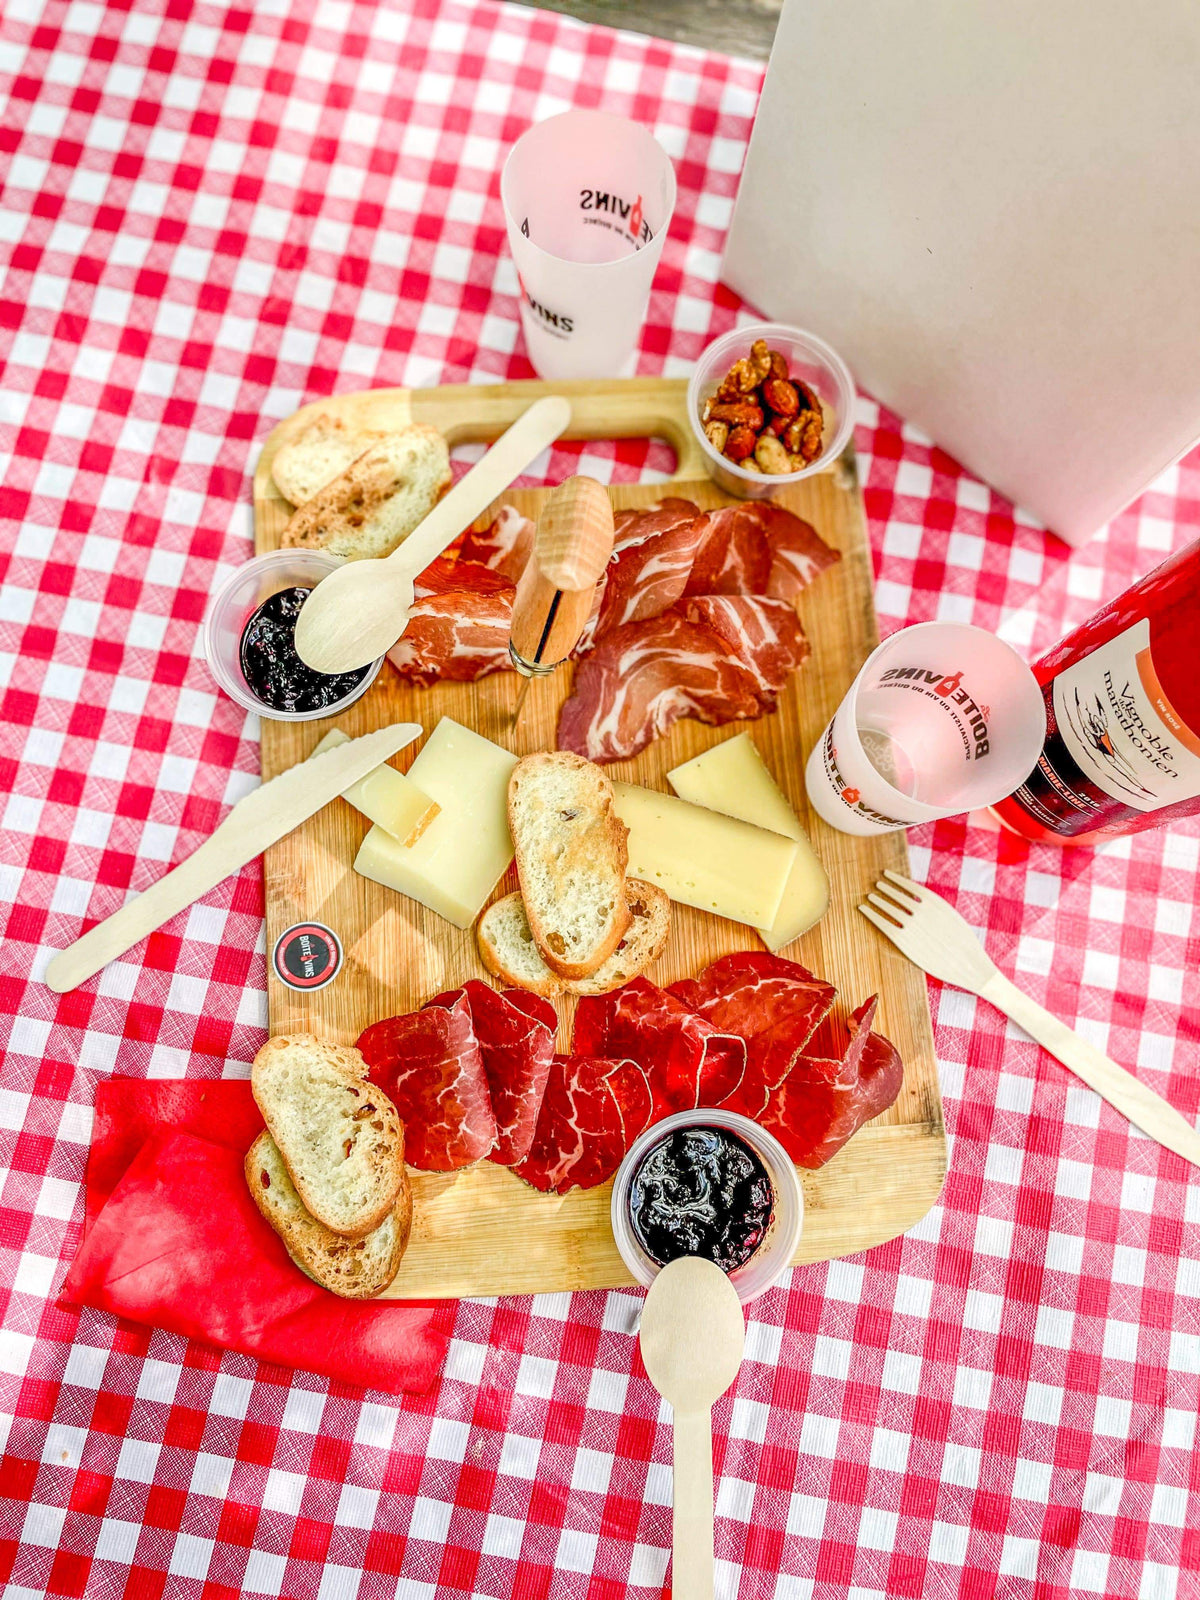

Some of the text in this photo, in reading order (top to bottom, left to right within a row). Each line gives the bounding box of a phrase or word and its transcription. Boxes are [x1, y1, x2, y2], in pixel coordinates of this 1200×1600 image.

[526, 292, 574, 332] VINS
[1103, 670, 1179, 779] marathonien
[1120, 680, 1174, 761] Vignoble
[1038, 756, 1087, 808] MARIE-LINE
[304, 959, 315, 978] VINS
